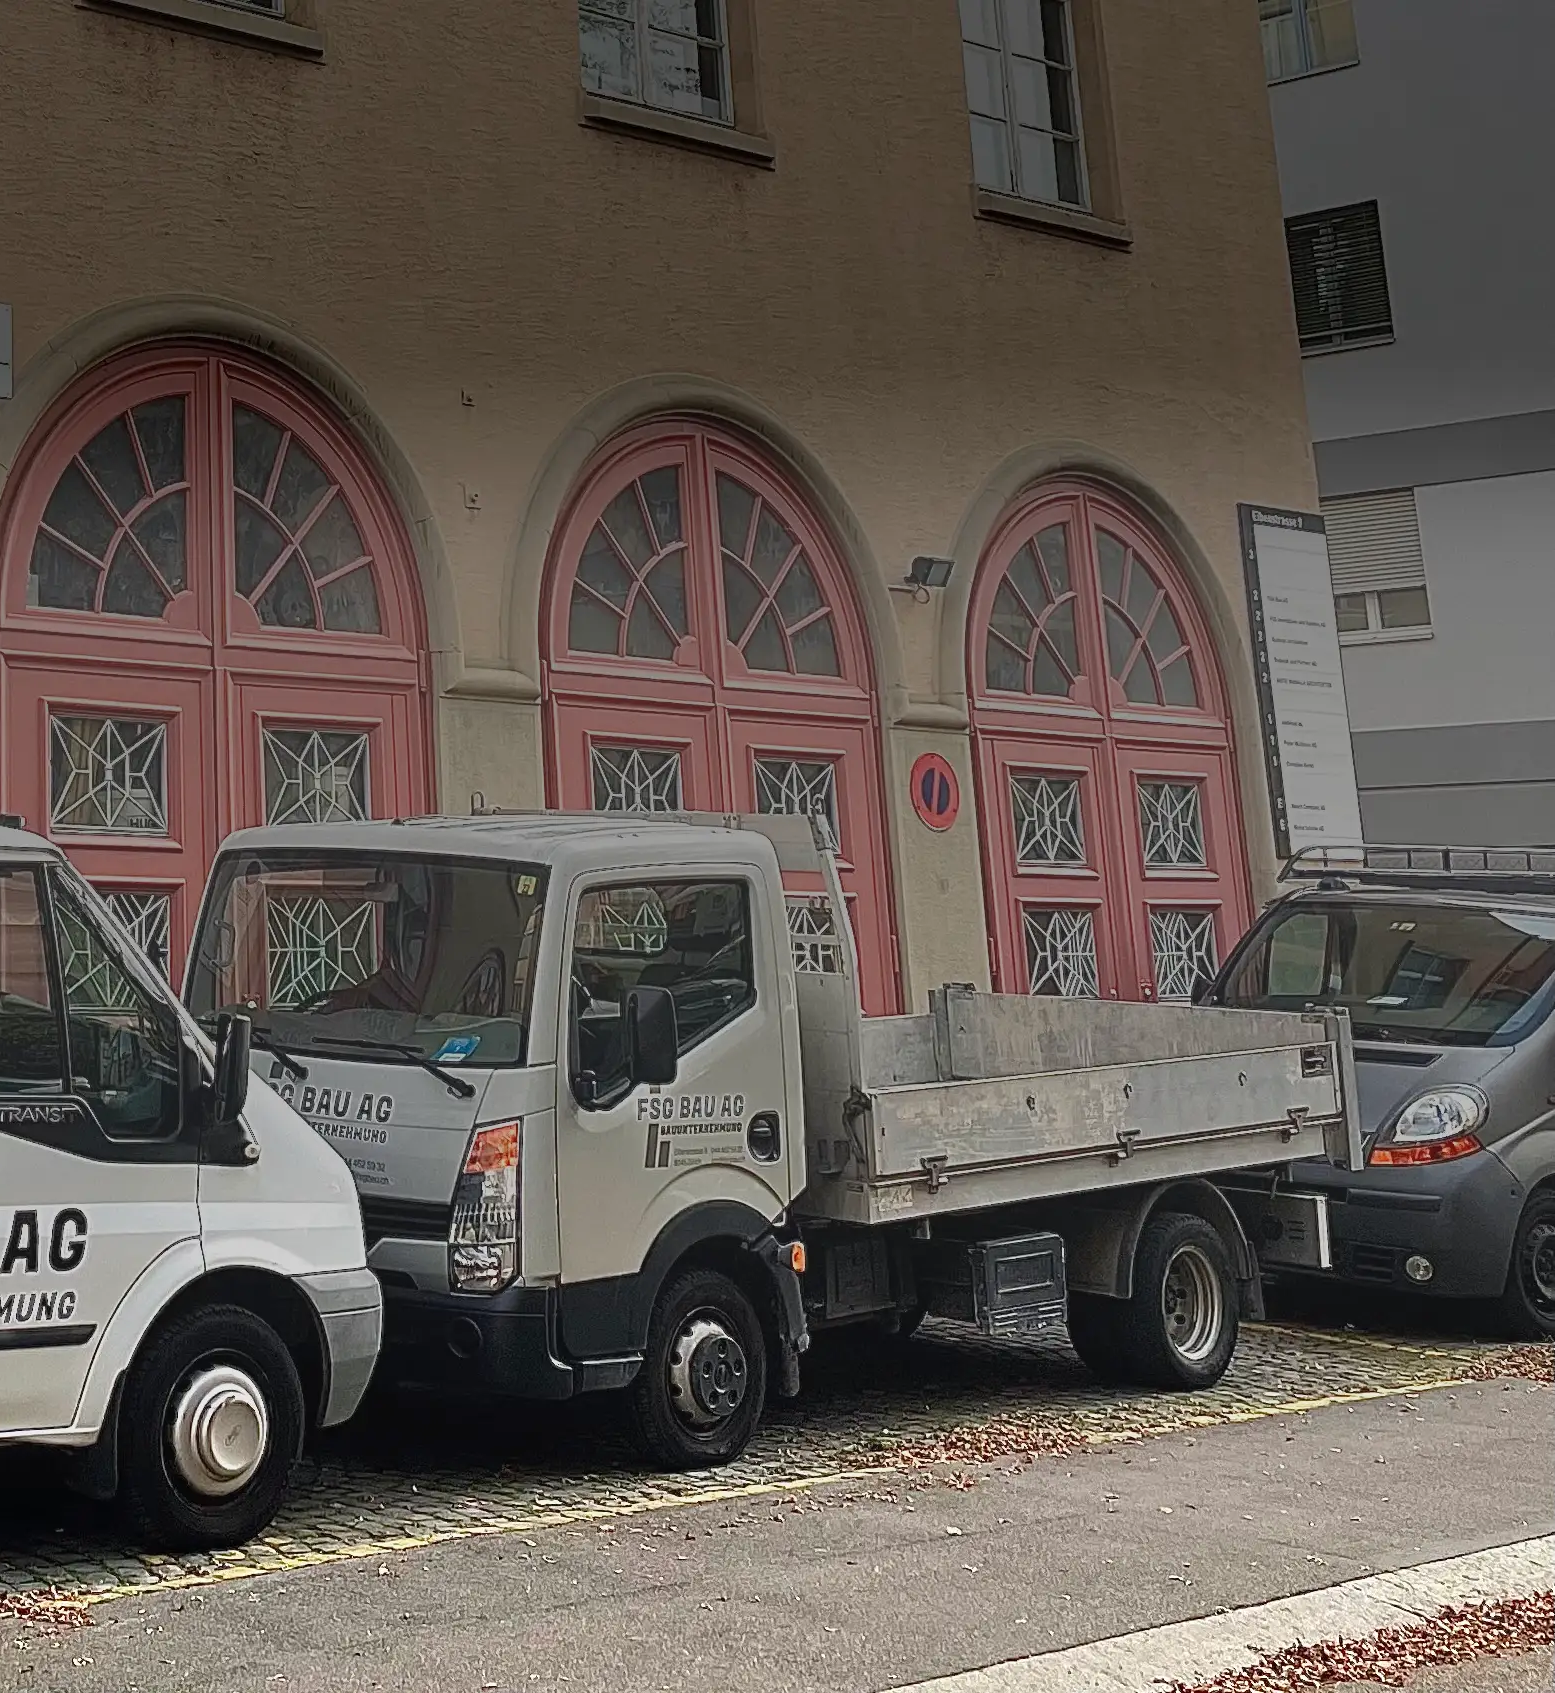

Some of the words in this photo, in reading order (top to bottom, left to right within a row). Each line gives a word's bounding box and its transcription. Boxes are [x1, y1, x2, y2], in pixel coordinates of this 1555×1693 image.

[300, 1085, 352, 1118] BAU
[356, 1093, 393, 1123] AG
[637, 1097, 674, 1121] FSG
[679, 1095, 716, 1119] BAU
[720, 1094, 745, 1117] AG
[660, 1122, 743, 1136] BAUUNTERNEHMUNG
[0, 1208, 88, 1275] AG
